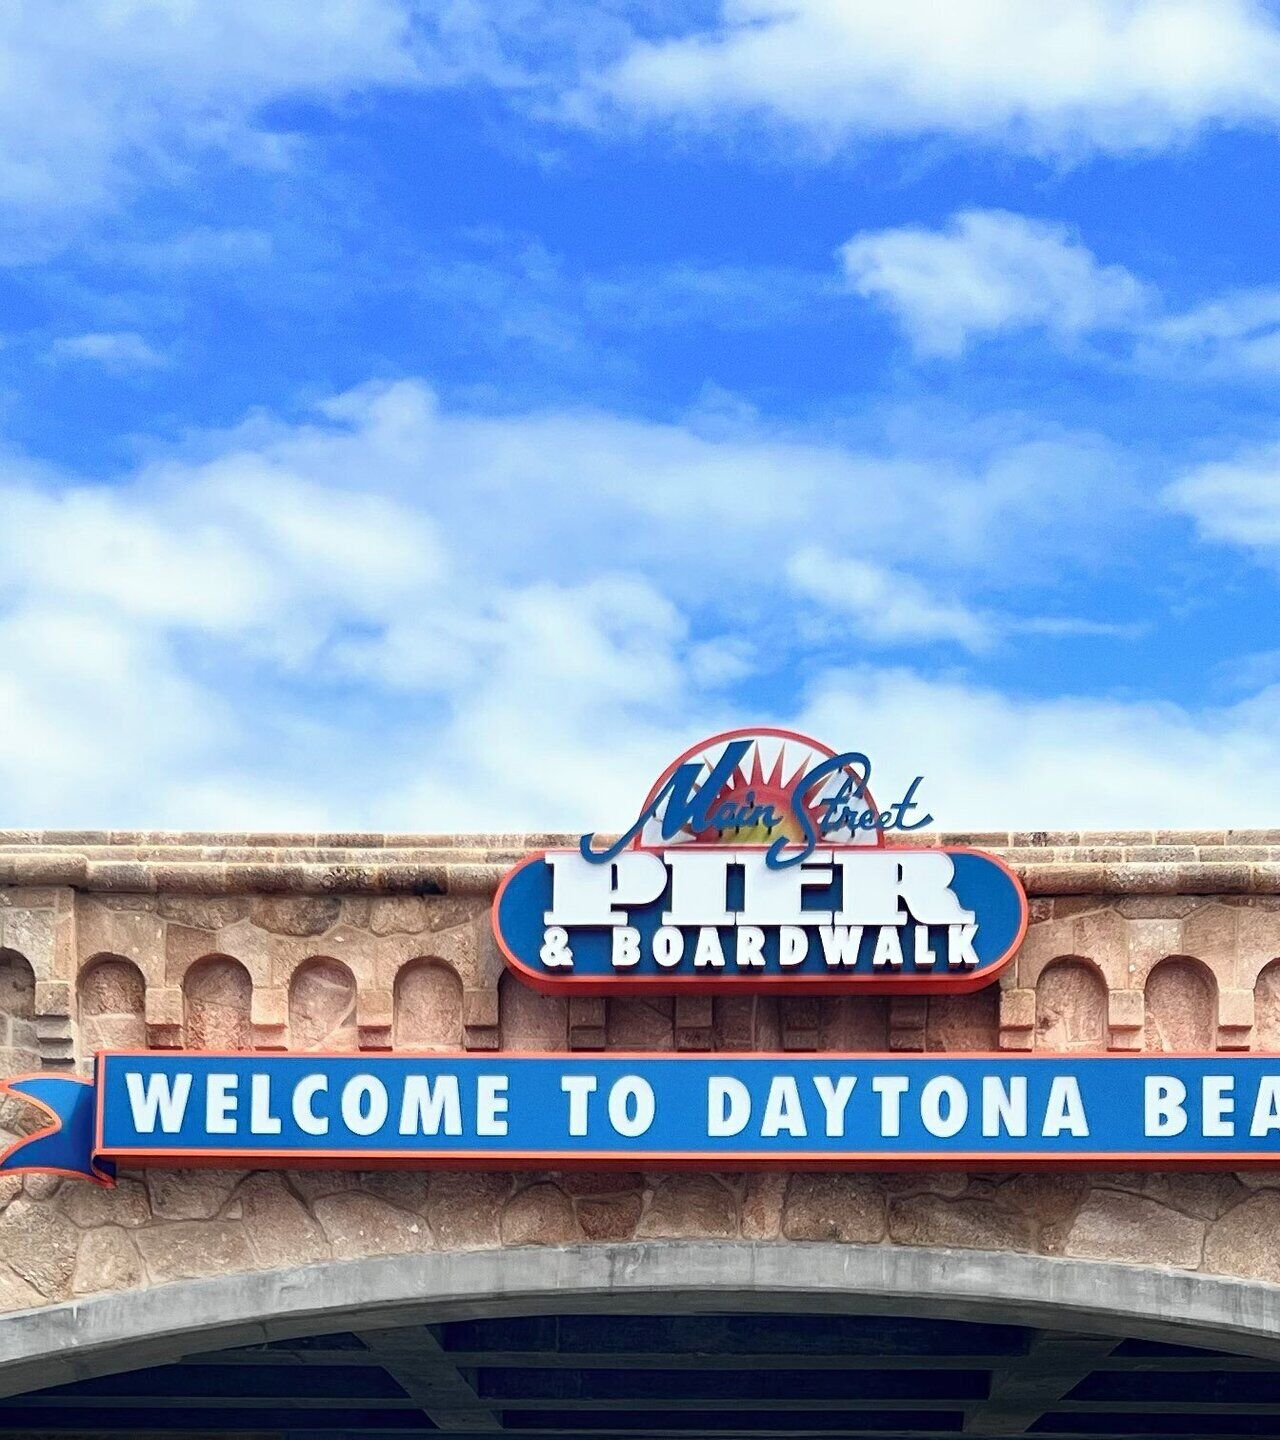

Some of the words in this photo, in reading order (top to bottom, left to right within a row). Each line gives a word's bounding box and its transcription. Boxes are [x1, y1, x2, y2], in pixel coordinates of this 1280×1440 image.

[580, 740, 784, 864] Main
[765, 752, 934, 870] Street
[543, 850, 977, 927] PIER
[538, 926, 575, 968] &
[611, 925, 981, 970] BOARDWALK
[124, 1072, 510, 1136] WELCOME
[560, 1075, 657, 1138] TO
[707, 1075, 1091, 1139] DAYTONA
